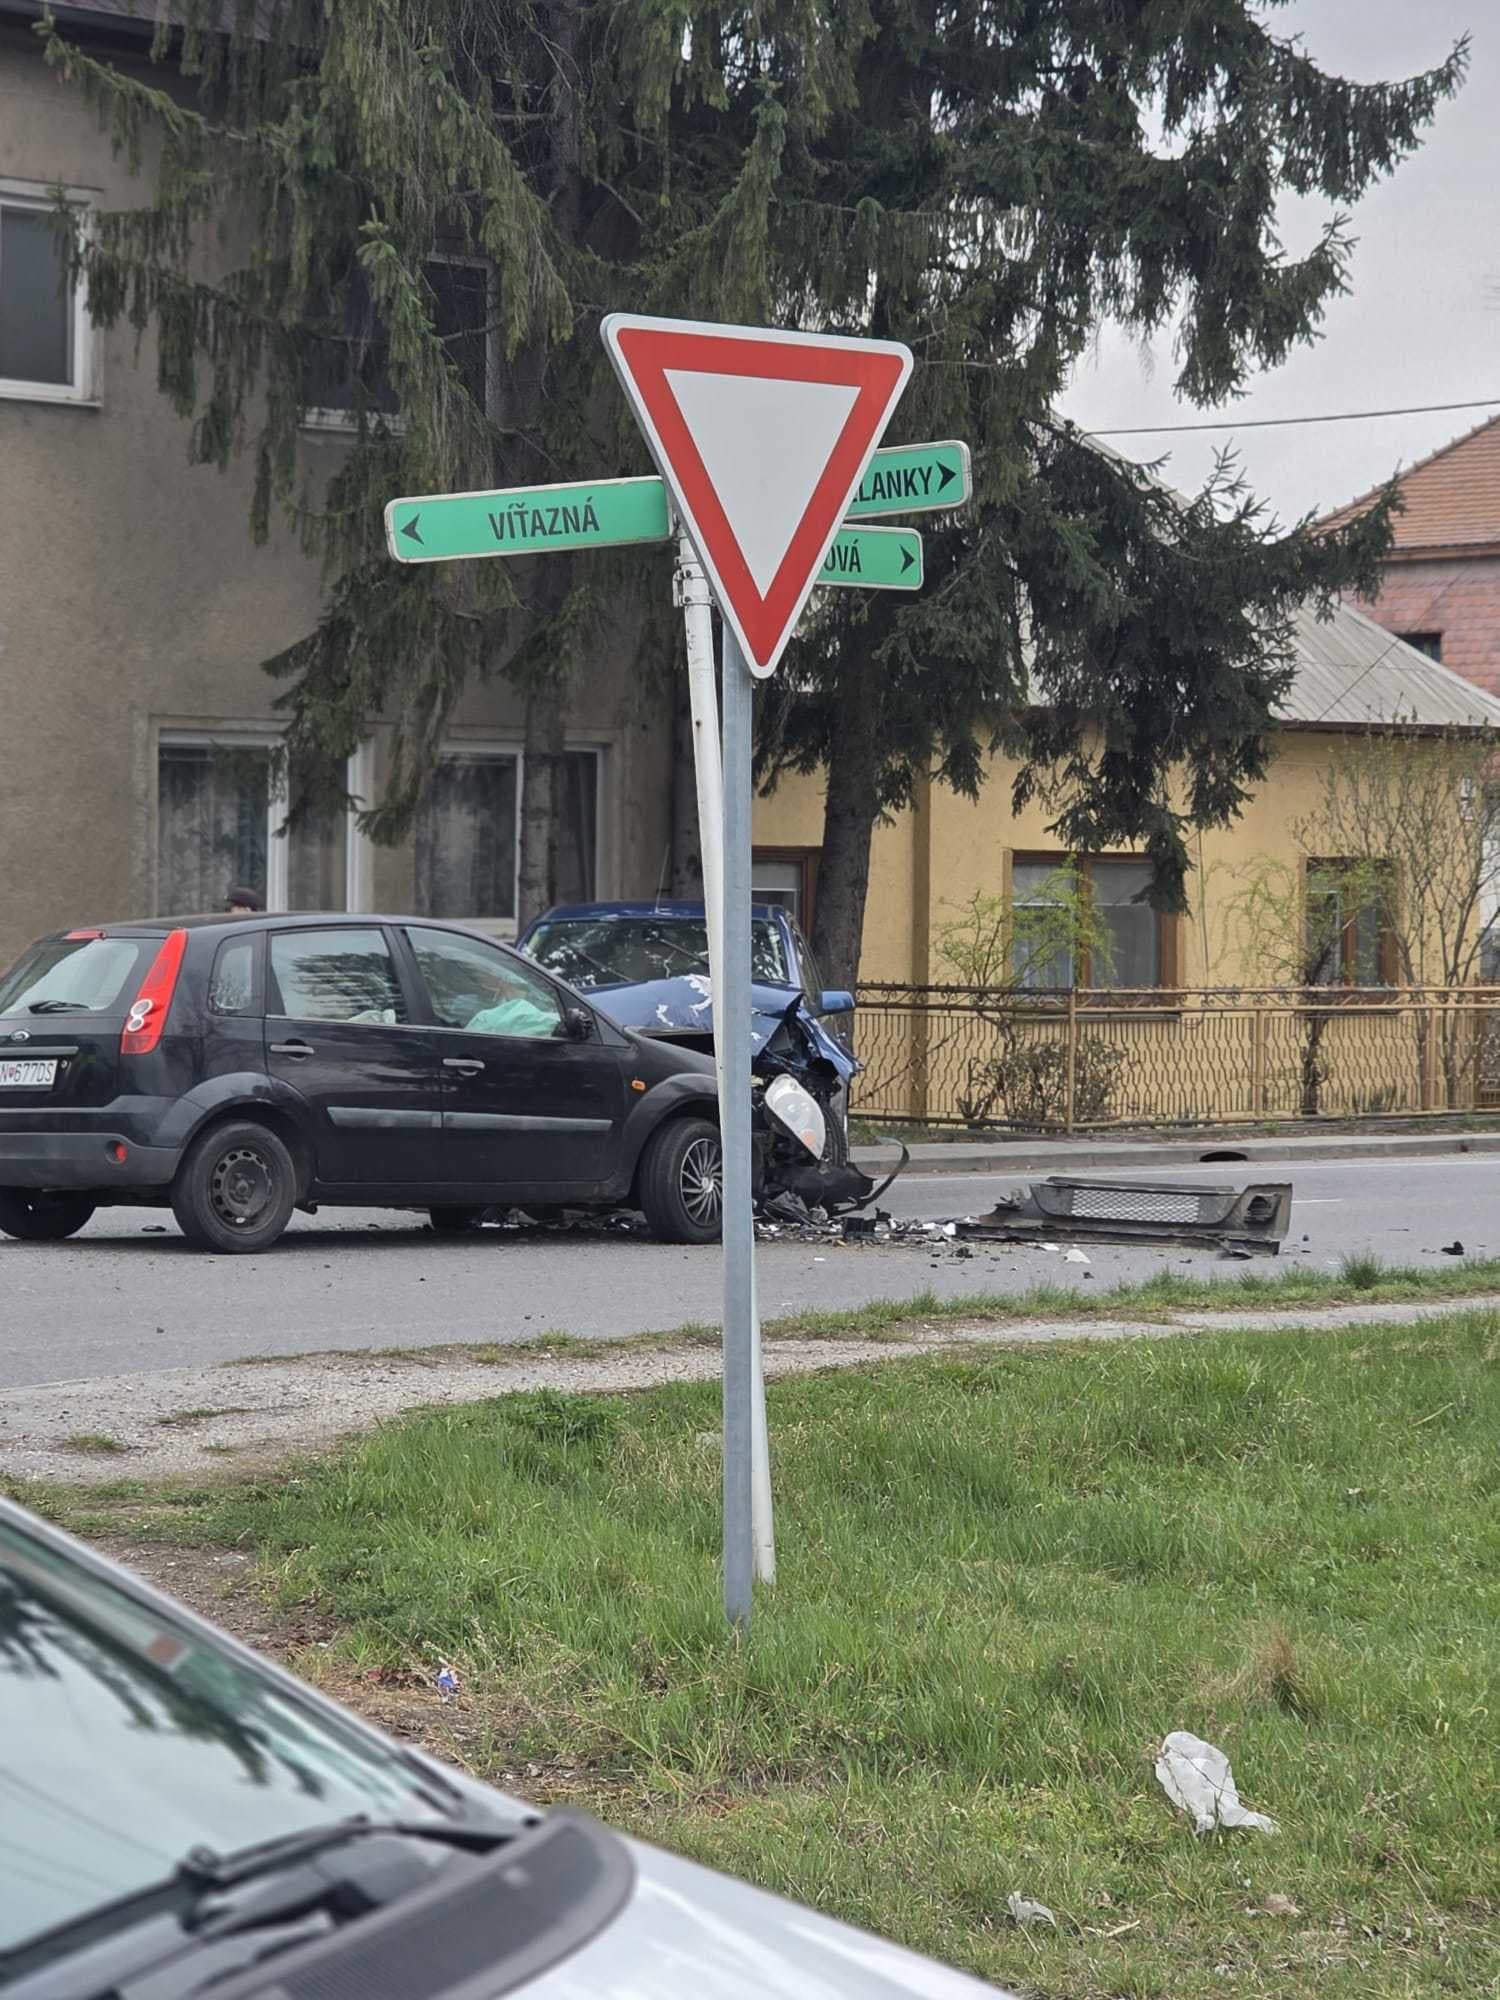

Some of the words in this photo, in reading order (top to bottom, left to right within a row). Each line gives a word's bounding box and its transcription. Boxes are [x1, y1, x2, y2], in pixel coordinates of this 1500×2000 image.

[852, 466, 933, 503] LANKY
[488, 496, 600, 541] VÍŤAZNÁ
[823, 538, 862, 574] OVÁ
